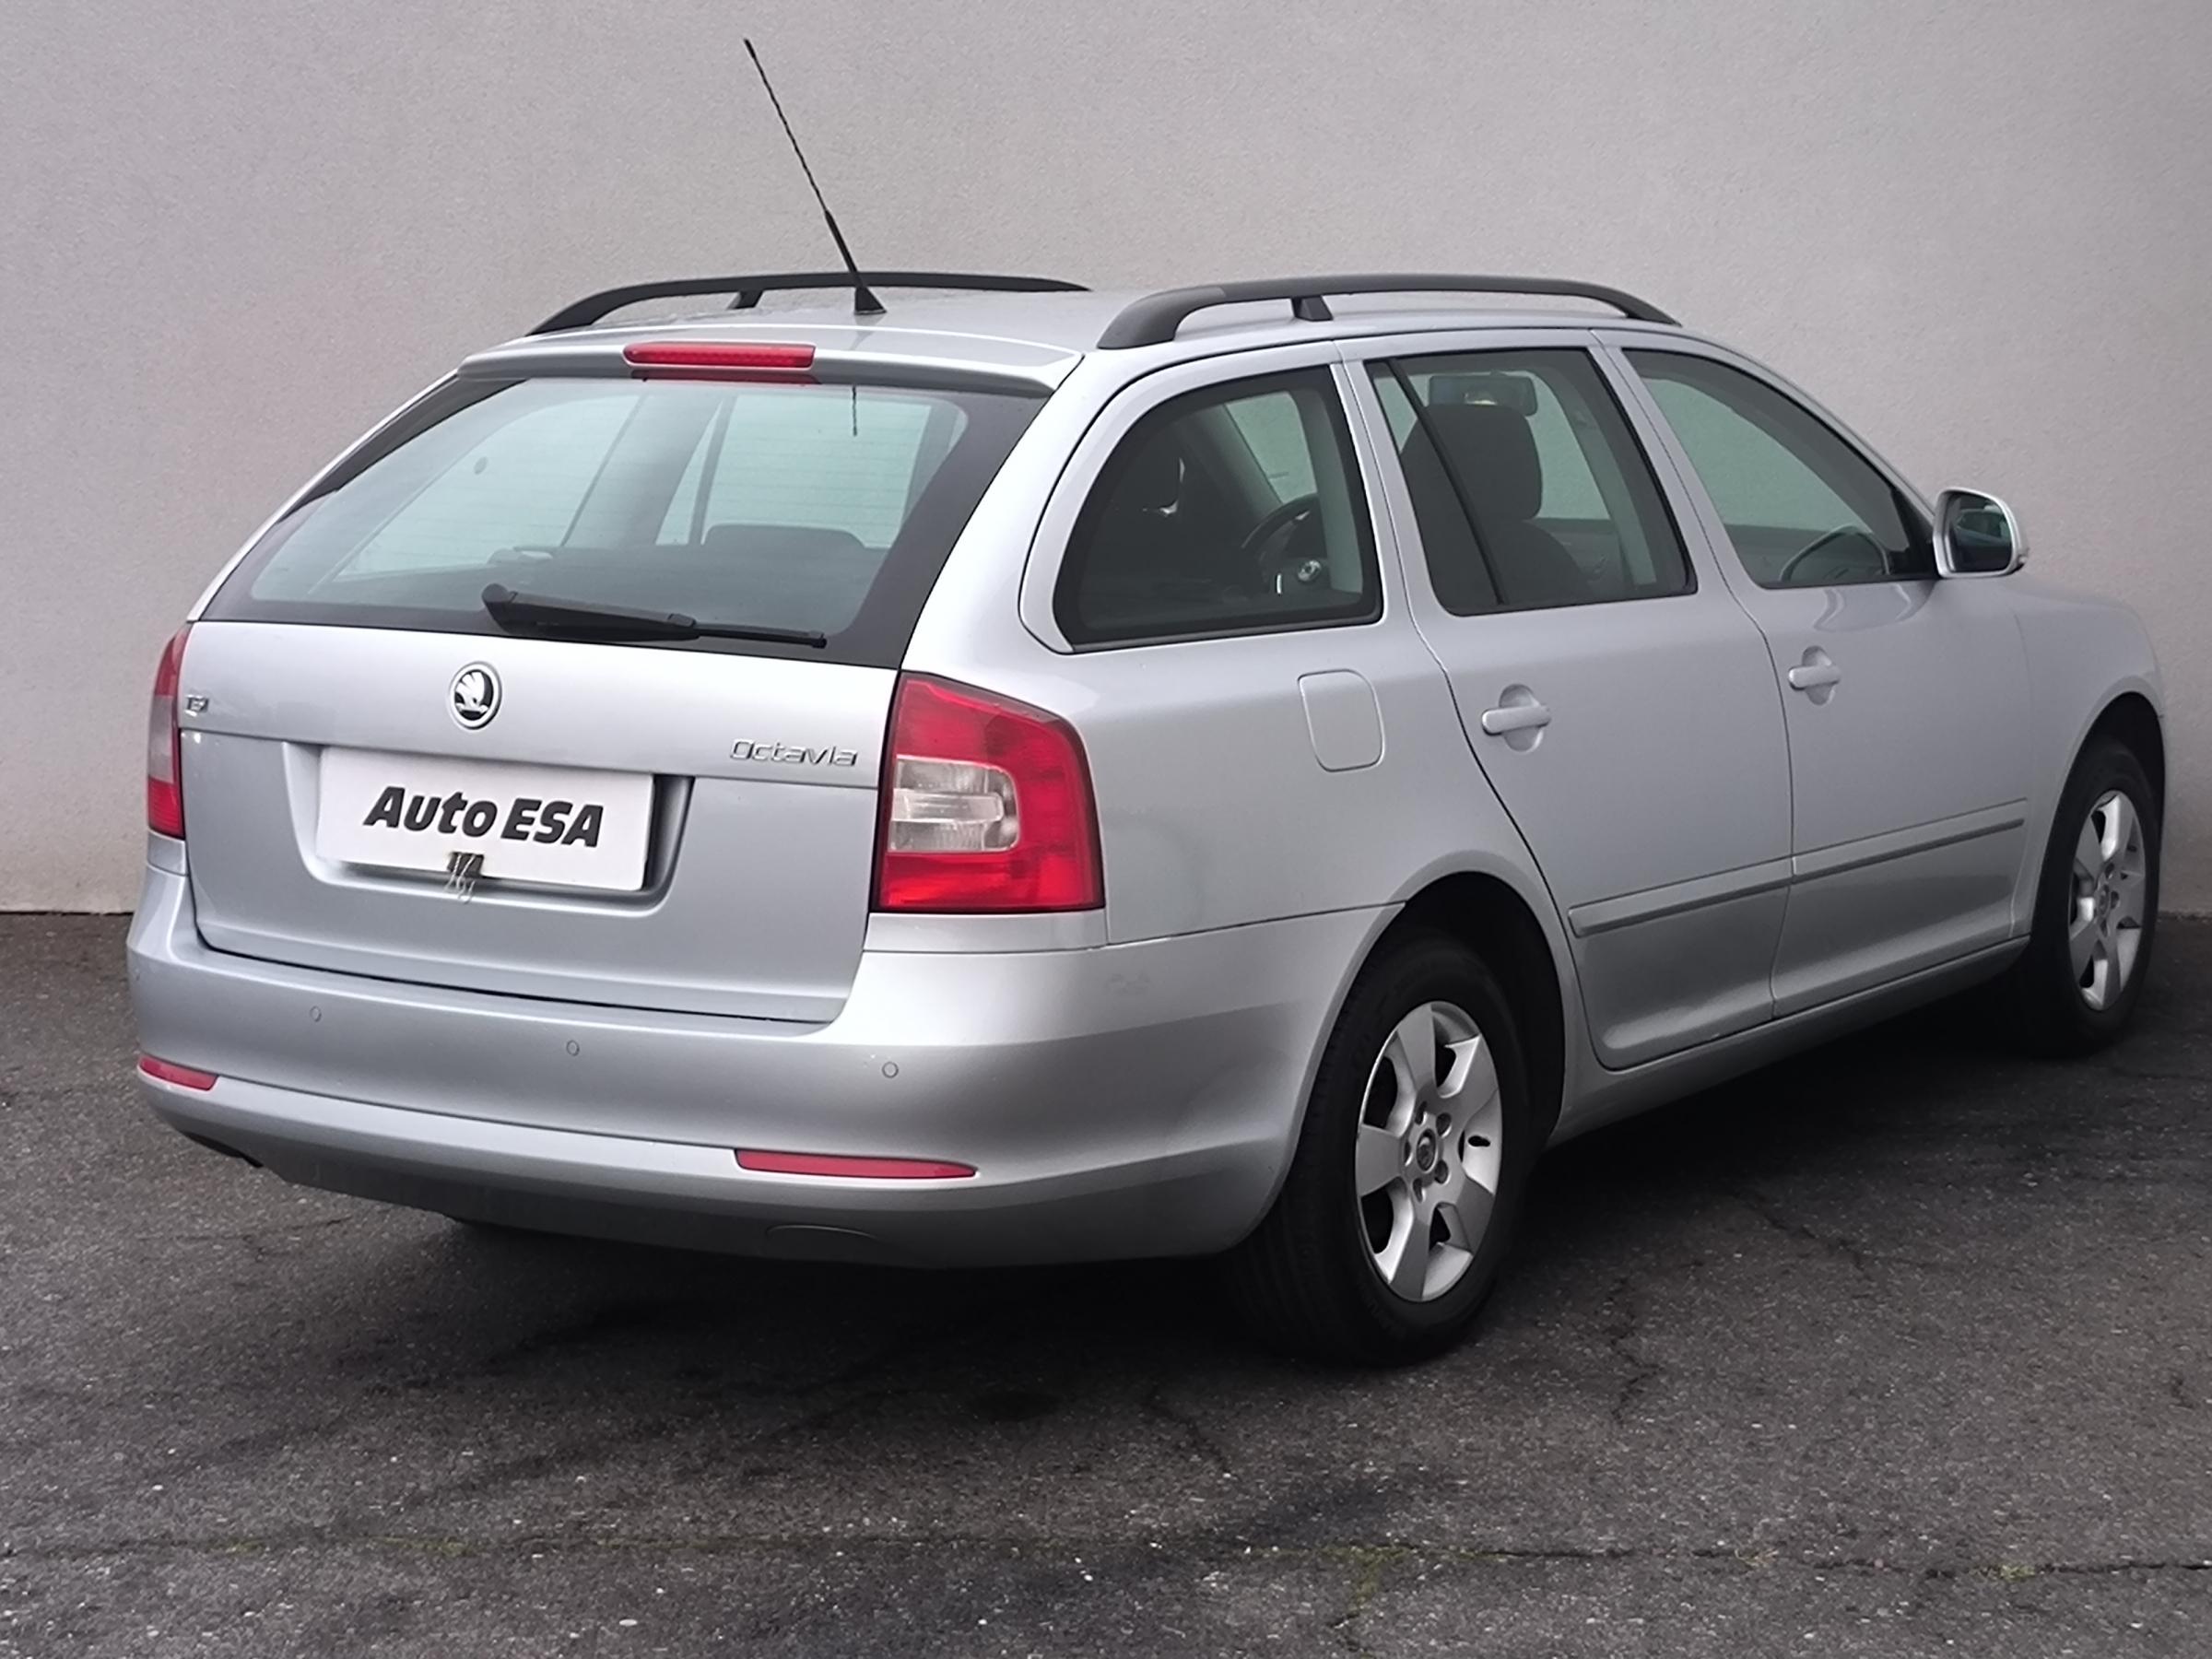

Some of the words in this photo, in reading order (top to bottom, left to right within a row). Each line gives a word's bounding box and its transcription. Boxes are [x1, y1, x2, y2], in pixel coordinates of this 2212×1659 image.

[730, 738, 858, 767] Octavia
[363, 786, 498, 838] Auto
[500, 798, 605, 848] ESA
